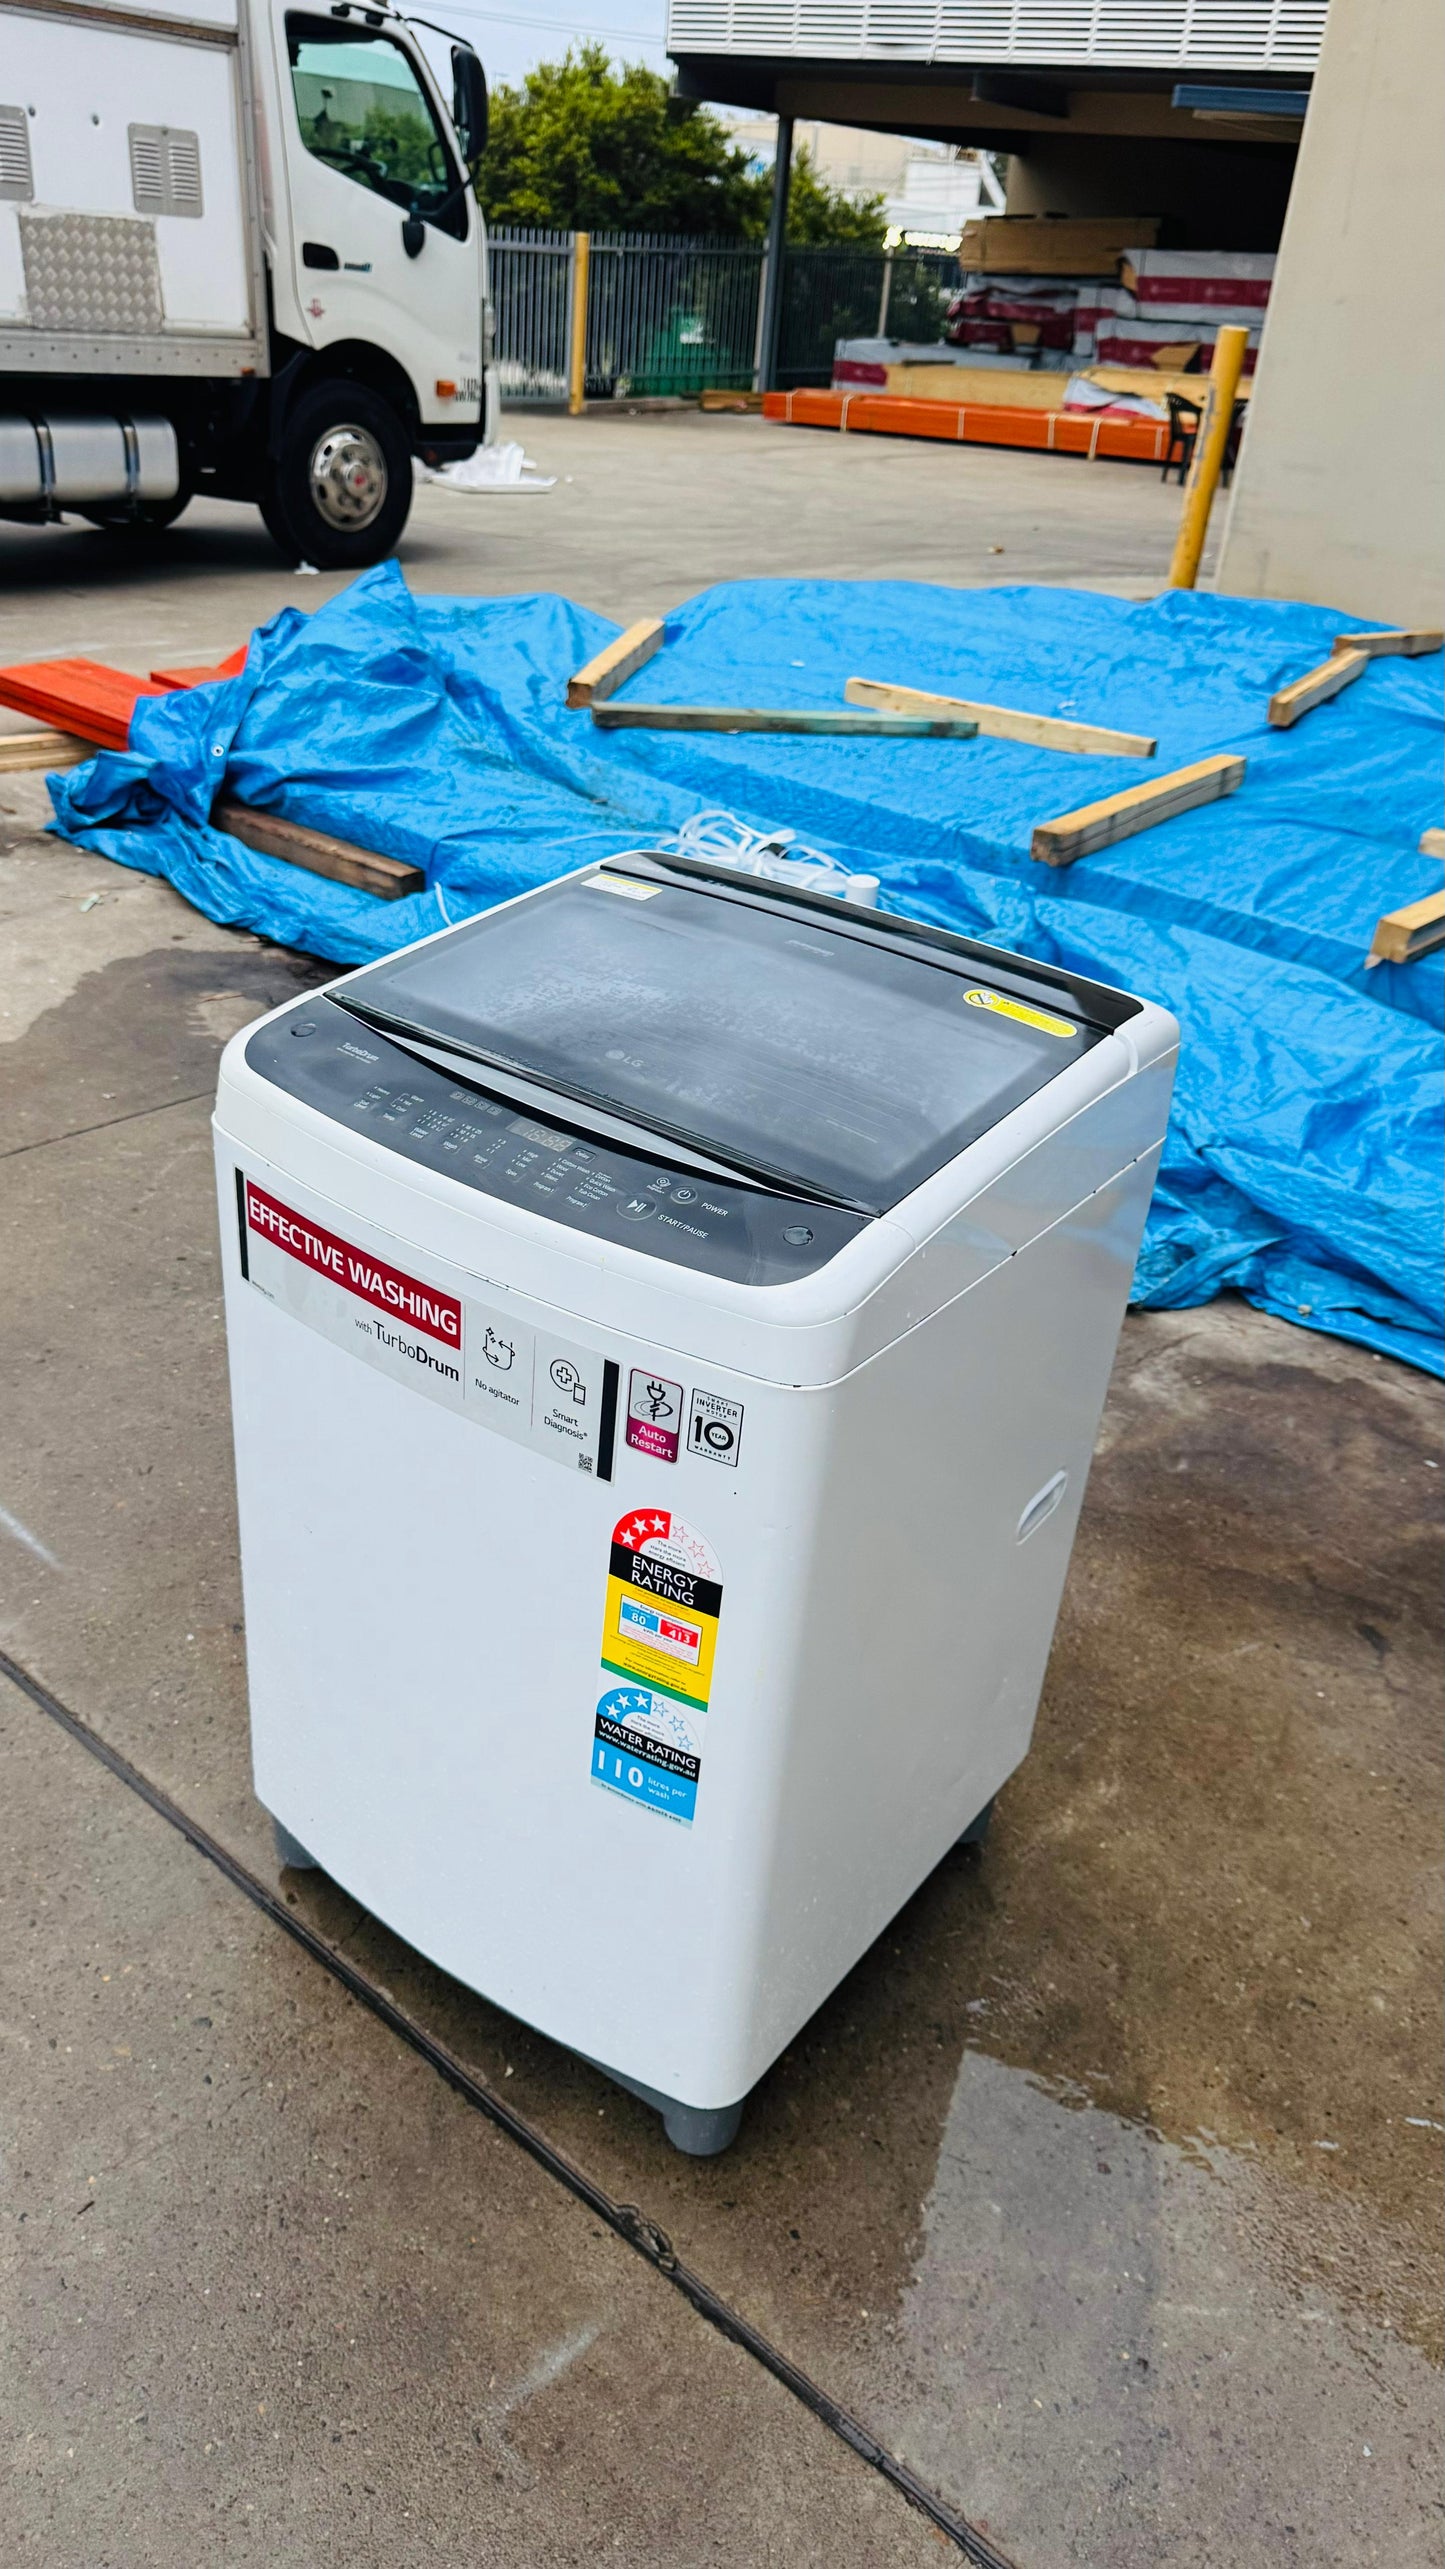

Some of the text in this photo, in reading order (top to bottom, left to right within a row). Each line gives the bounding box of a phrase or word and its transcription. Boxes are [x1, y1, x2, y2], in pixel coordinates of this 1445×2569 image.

[622, 1056, 644, 1067] LG
[701, 1202, 728, 1217] POWER
[658, 1214, 709, 1239] START/PAUSE
[249, 1195, 457, 1335] EFFECTIVE WASHING
[355, 1319, 460, 1382] with TurboDrum
[475, 1378, 520, 1406] No agitator
[552, 1408, 579, 1427] Smart
[696, 1397, 738, 1418] INVERTER
[639, 1425, 666, 1443] Auto
[695, 1415, 734, 1451] 10
[711, 1431, 726, 1442] YEAR
[630, 1433, 673, 1458] Restart
[694, 1445, 731, 1460] WARRANTY
[632, 1555, 698, 1591] ENERGY
[632, 1570, 695, 1605] RATING
[631, 1612, 646, 1625] 80
[669, 1630, 691, 1644] 413
[598, 1730, 696, 1778] www.waterrating.gov.au
[600, 1718, 697, 1769] WATER RATING
[598, 1749, 643, 1788] 110
[648, 1777, 687, 1798] litres per
[648, 1787, 670, 1800] wash
